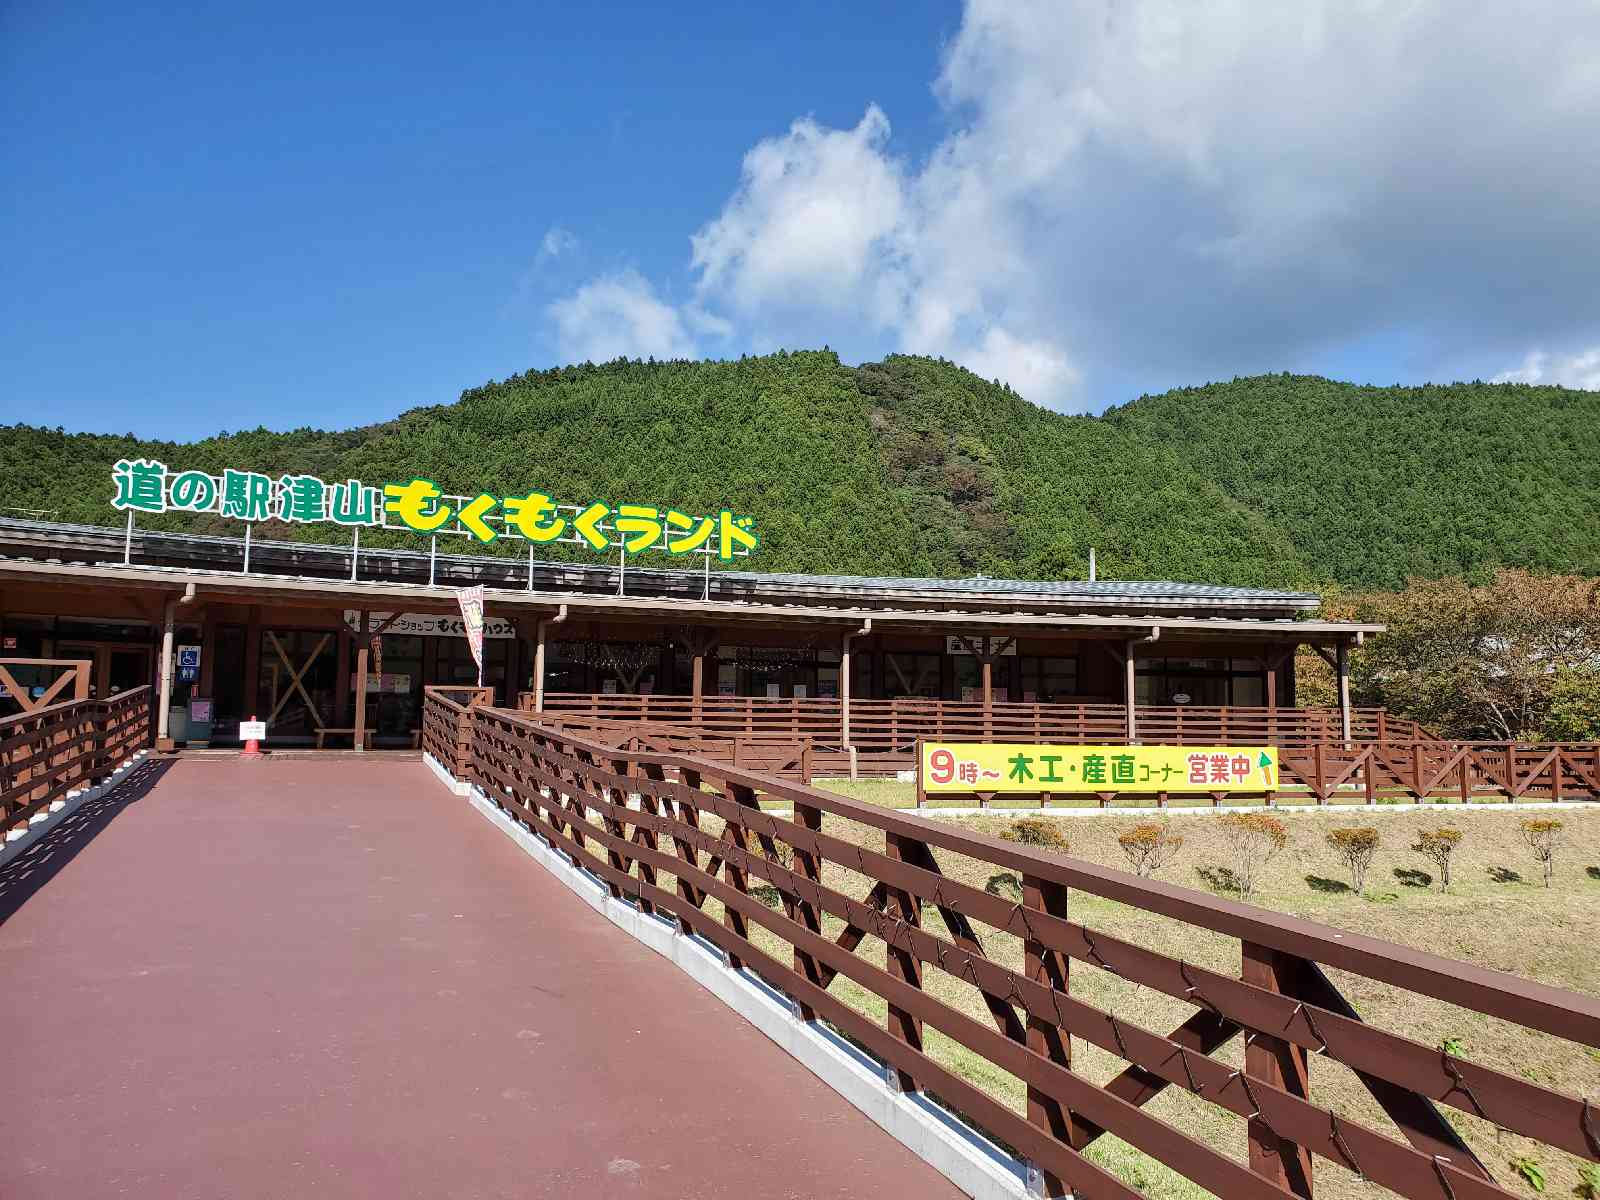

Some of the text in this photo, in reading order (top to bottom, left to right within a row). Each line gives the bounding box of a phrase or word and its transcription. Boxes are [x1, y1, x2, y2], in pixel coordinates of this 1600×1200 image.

[112, 459, 758, 561] 道の駅津山 もくもくランド
[1188, 754, 1250, 784] 営業中
